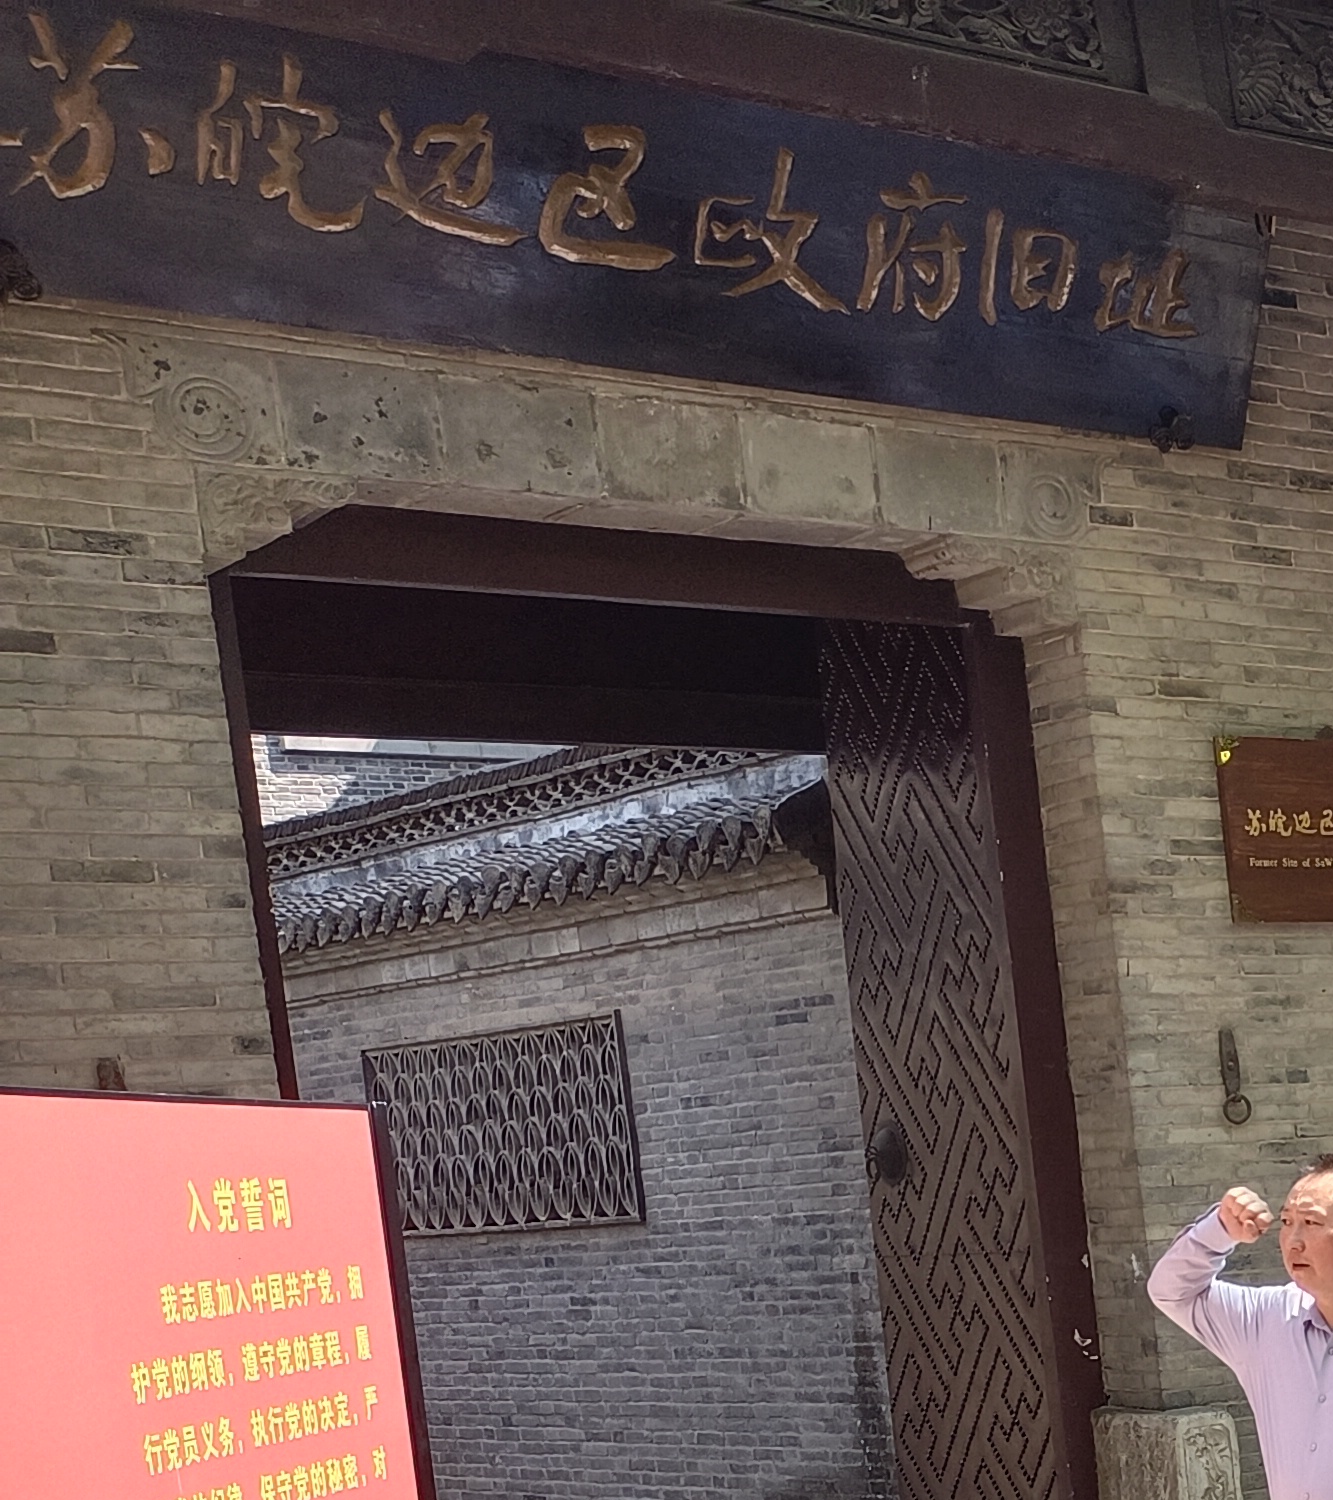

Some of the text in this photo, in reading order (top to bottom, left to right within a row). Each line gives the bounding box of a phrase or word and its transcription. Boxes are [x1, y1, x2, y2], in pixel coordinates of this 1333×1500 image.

[0, 16, 1200, 338] 苏皖边区政府旧址
[1249, 857, 1278, 868] Former
[1282, 857, 1298, 868] Site
[1302, 857, 1311, 868] of
[187, 1177, 292, 1233] 入党誓词
